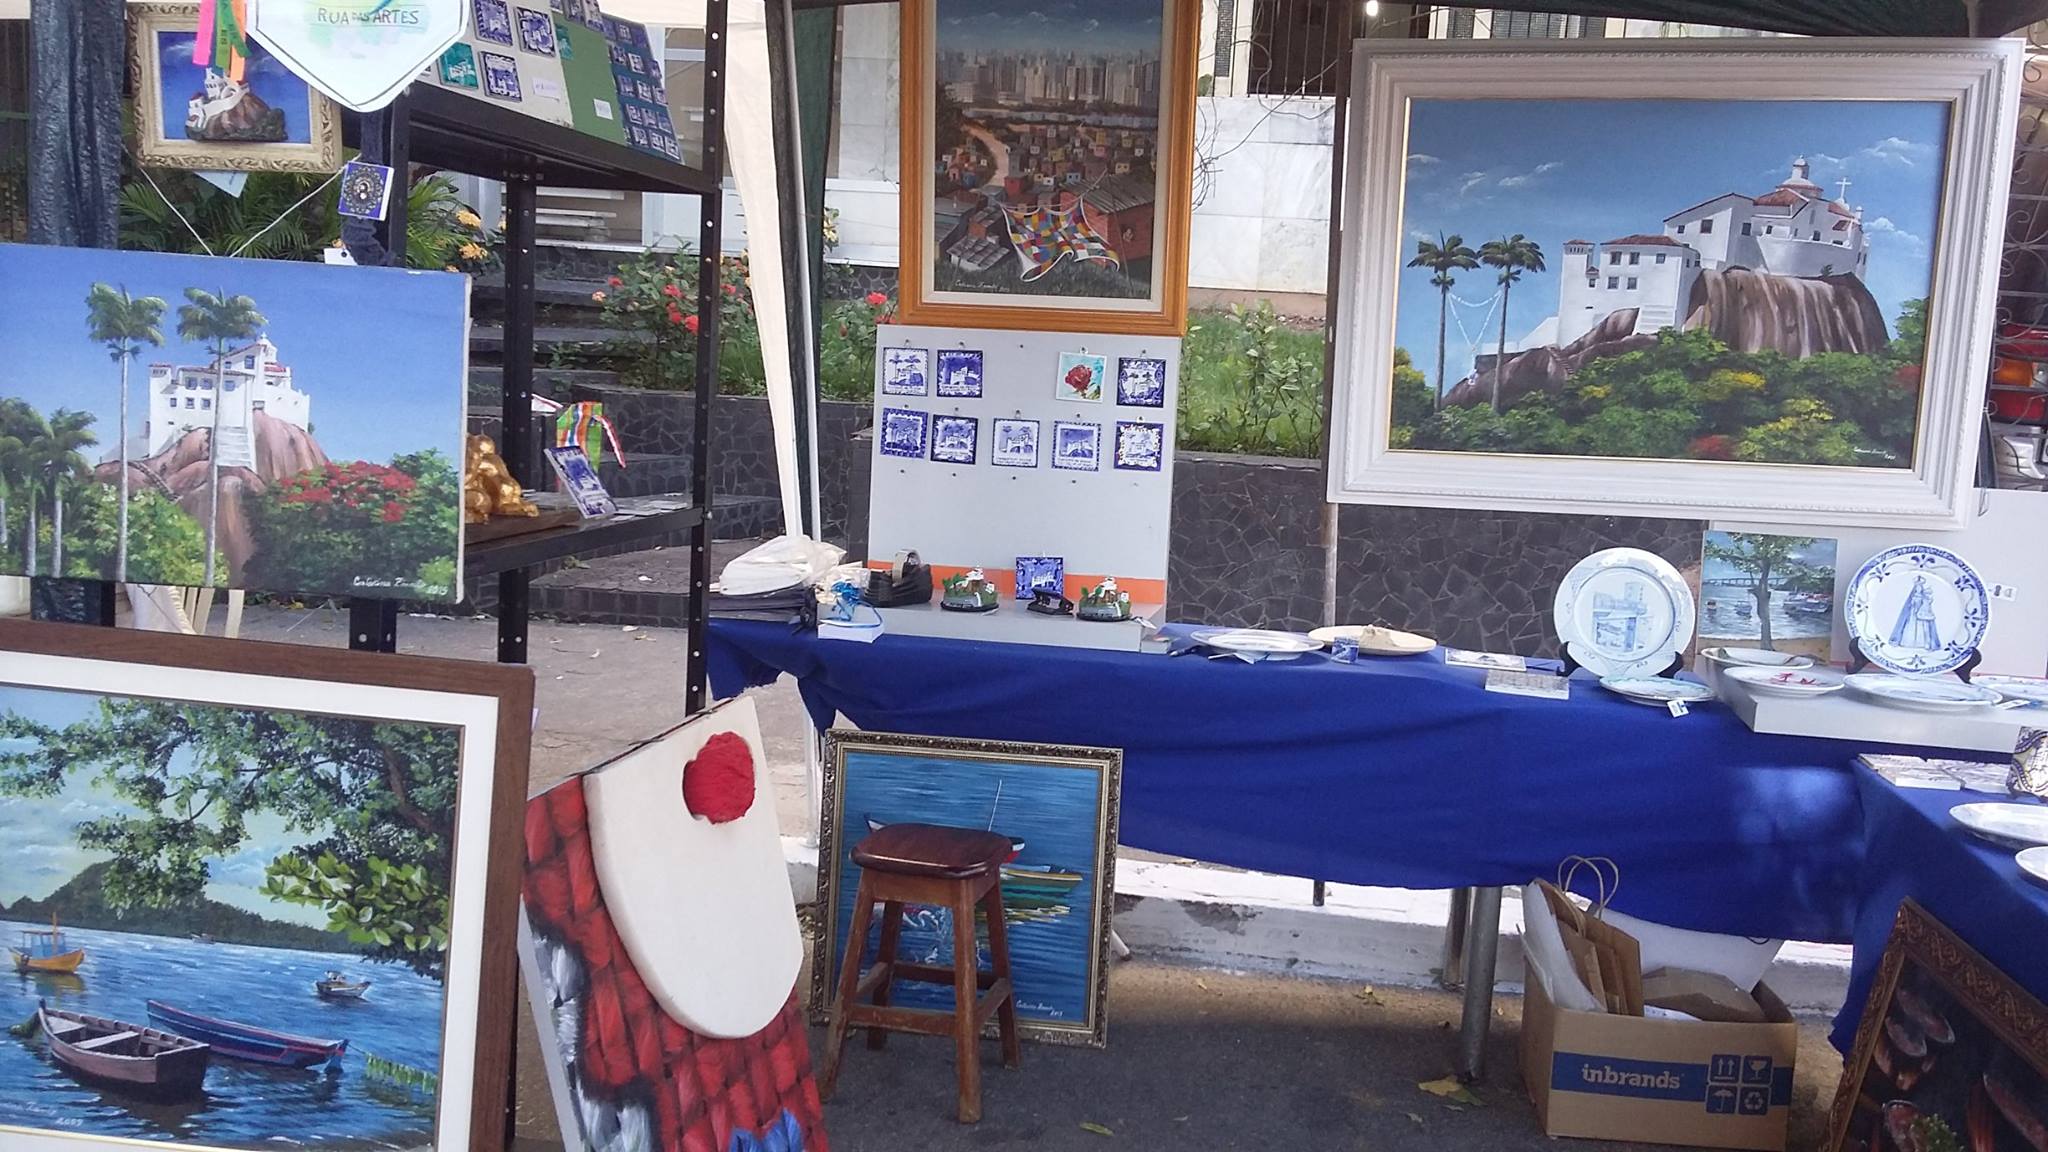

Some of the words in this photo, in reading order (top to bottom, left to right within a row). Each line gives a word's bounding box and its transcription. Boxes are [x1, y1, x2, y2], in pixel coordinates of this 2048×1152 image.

[317, 7, 349, 25] RUA
[372, 9, 419, 24] ARTES
[1581, 1063, 1681, 1089] inbrands
